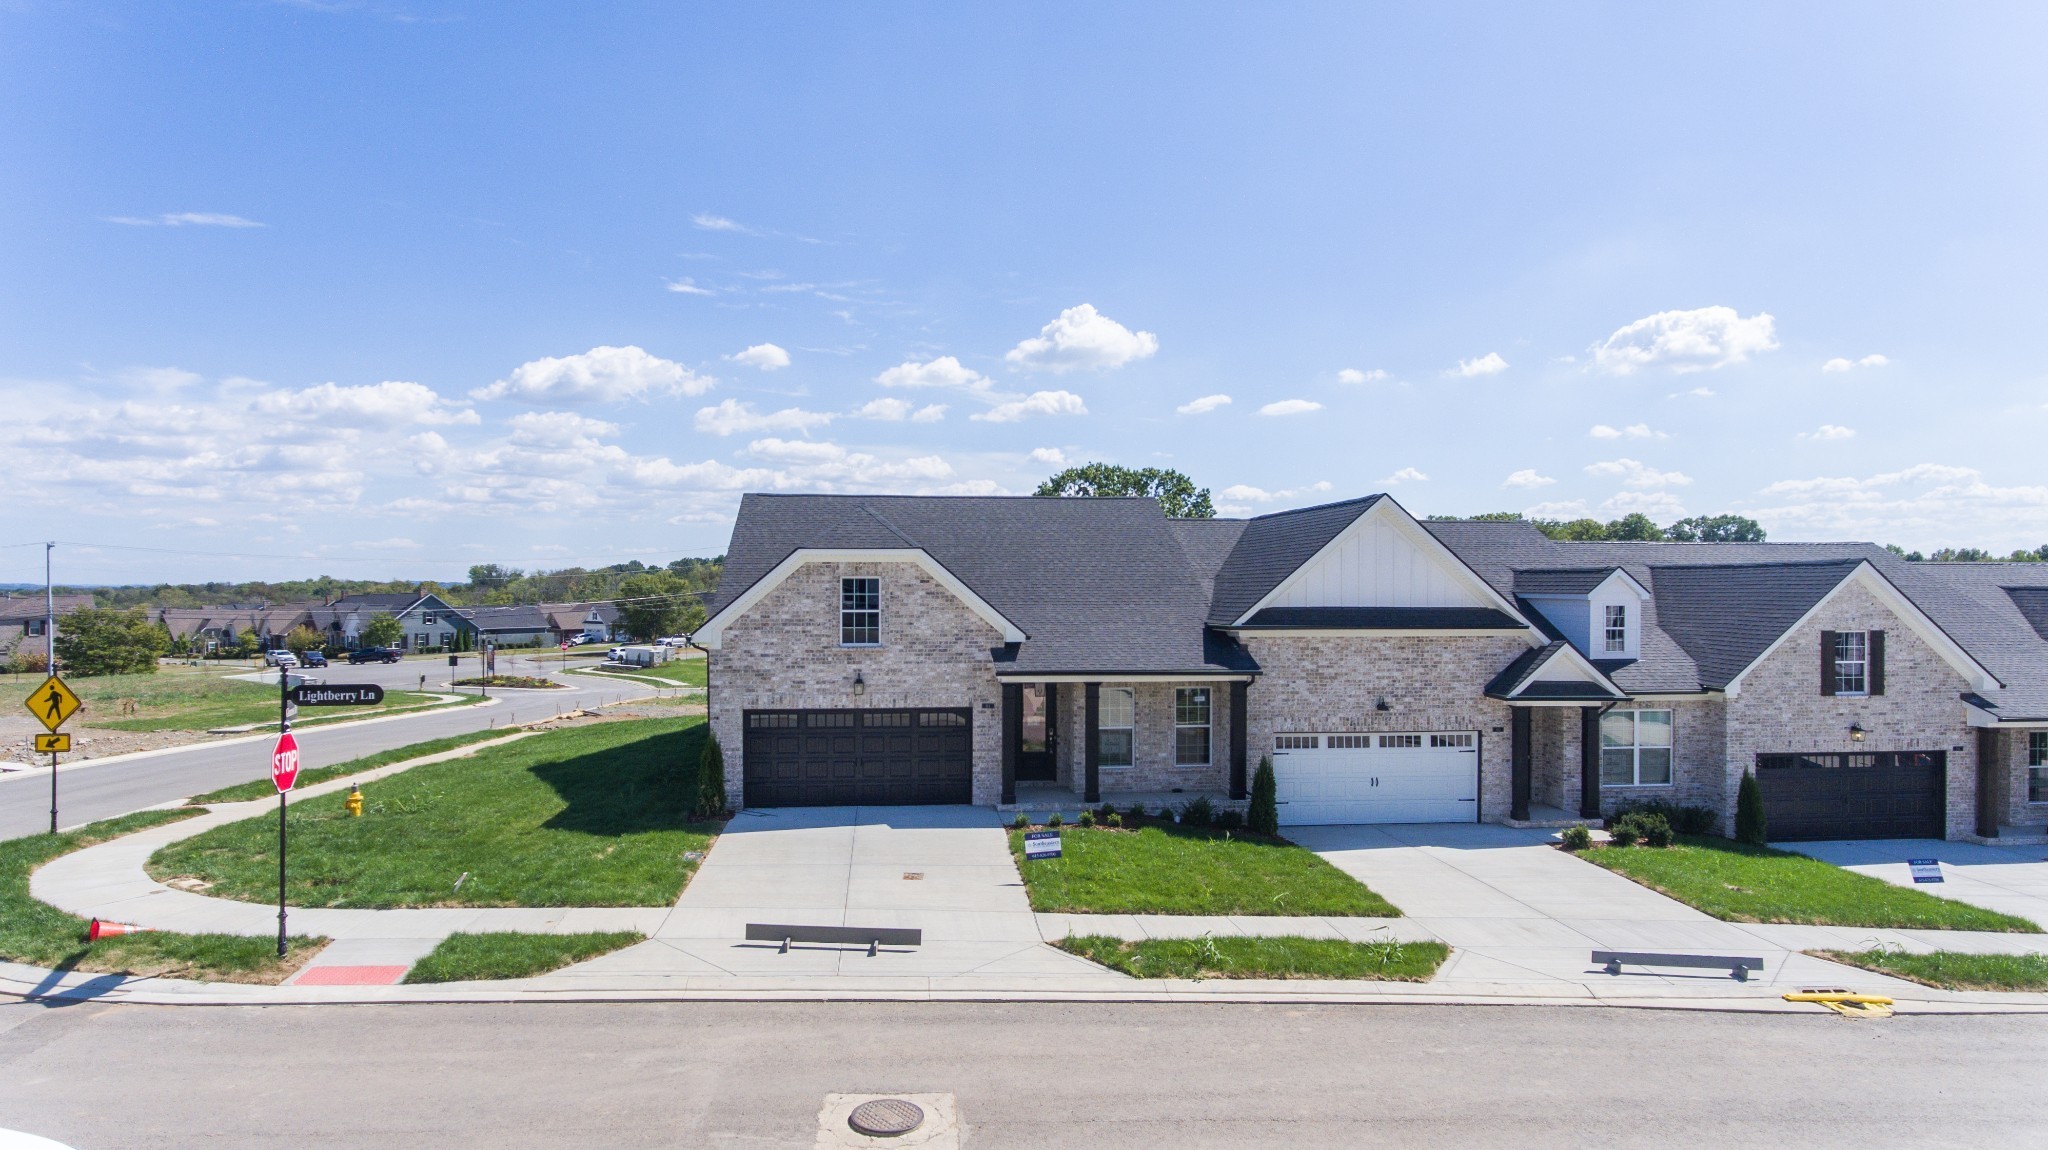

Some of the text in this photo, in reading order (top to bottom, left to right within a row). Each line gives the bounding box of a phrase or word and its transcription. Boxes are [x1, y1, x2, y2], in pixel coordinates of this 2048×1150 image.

[299, 689, 375, 703] Lightberry Ln
[274, 749, 297, 776] STOP
